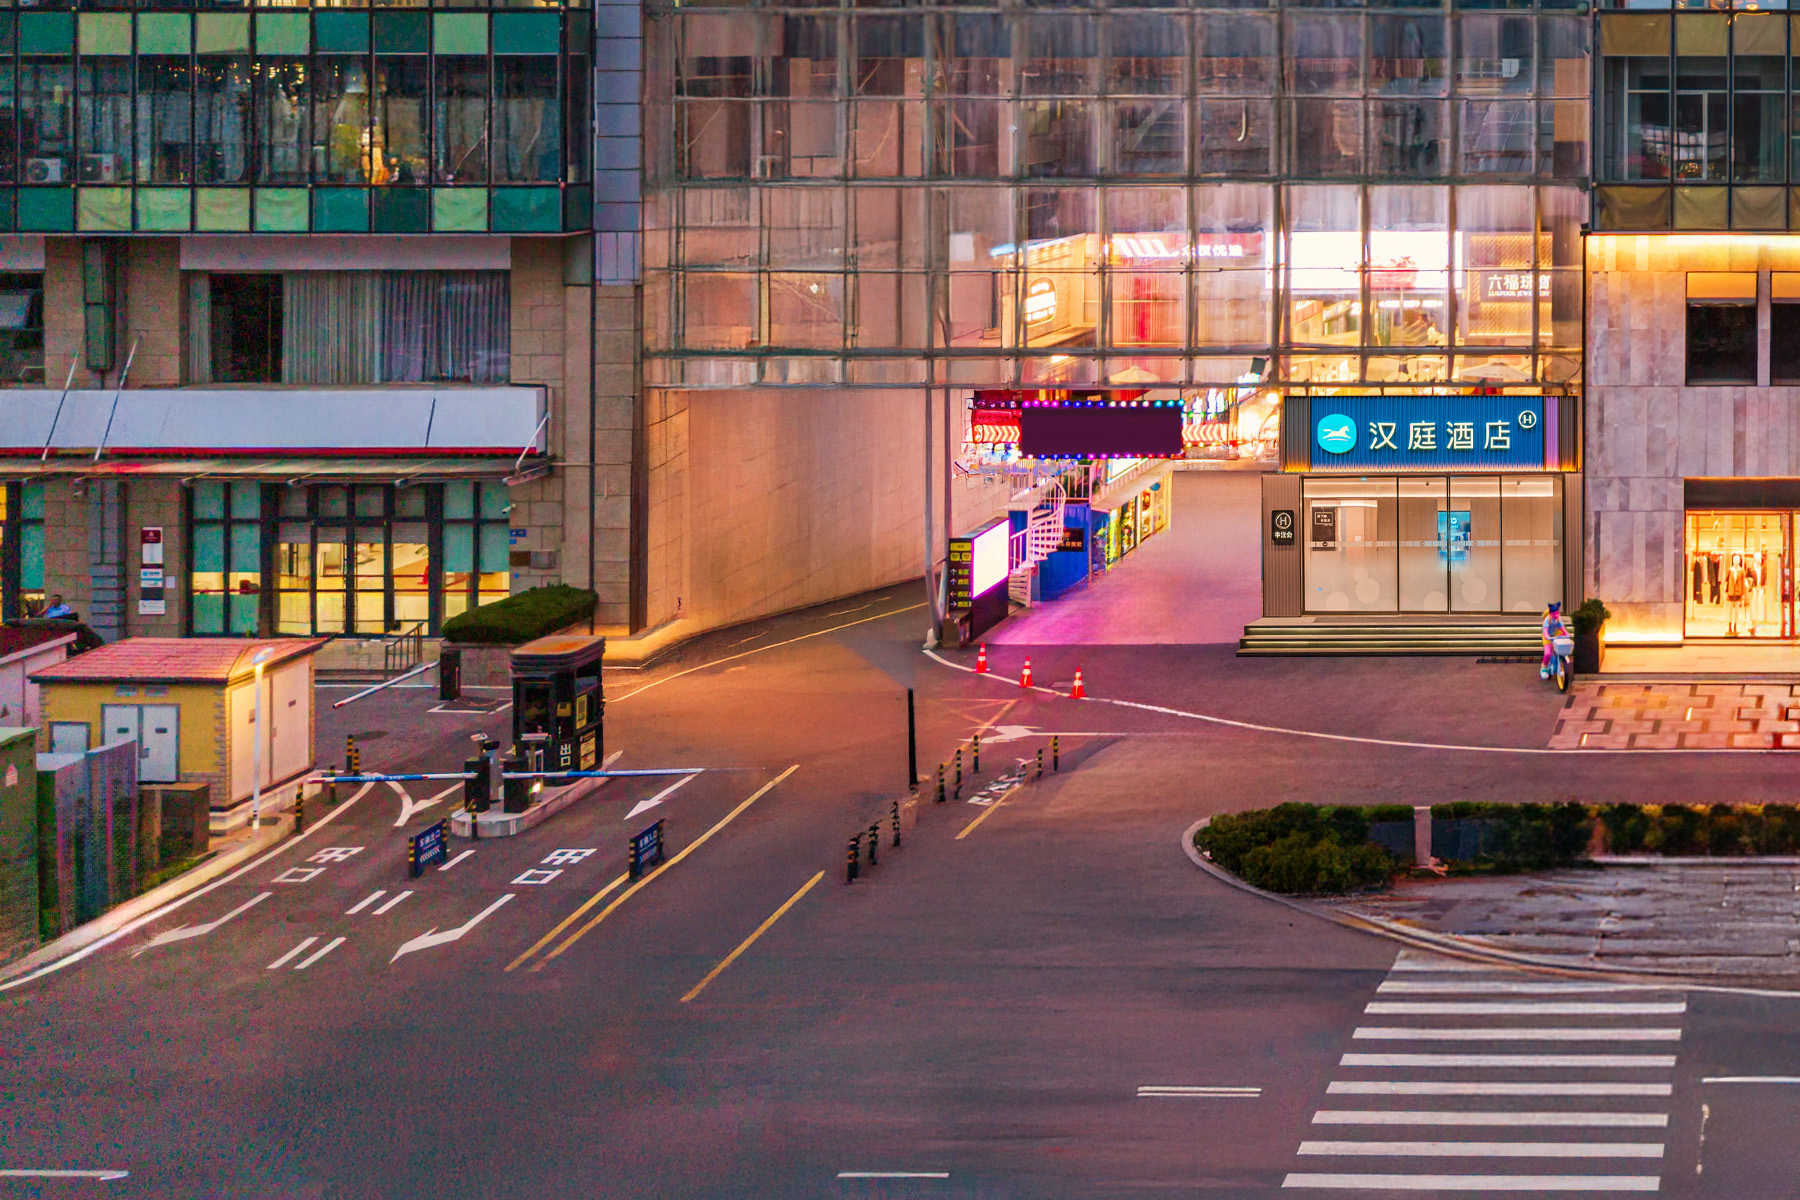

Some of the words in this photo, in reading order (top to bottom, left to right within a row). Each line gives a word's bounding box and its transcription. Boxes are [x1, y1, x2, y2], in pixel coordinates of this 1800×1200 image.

[1517, 290, 1551, 298] JEWEERY
[1369, 420, 1511, 450] 汉庭酒店
[560, 743, 572, 767] 出口
[270, 846, 365, 883] 出口
[510, 847, 598, 885] 出口
